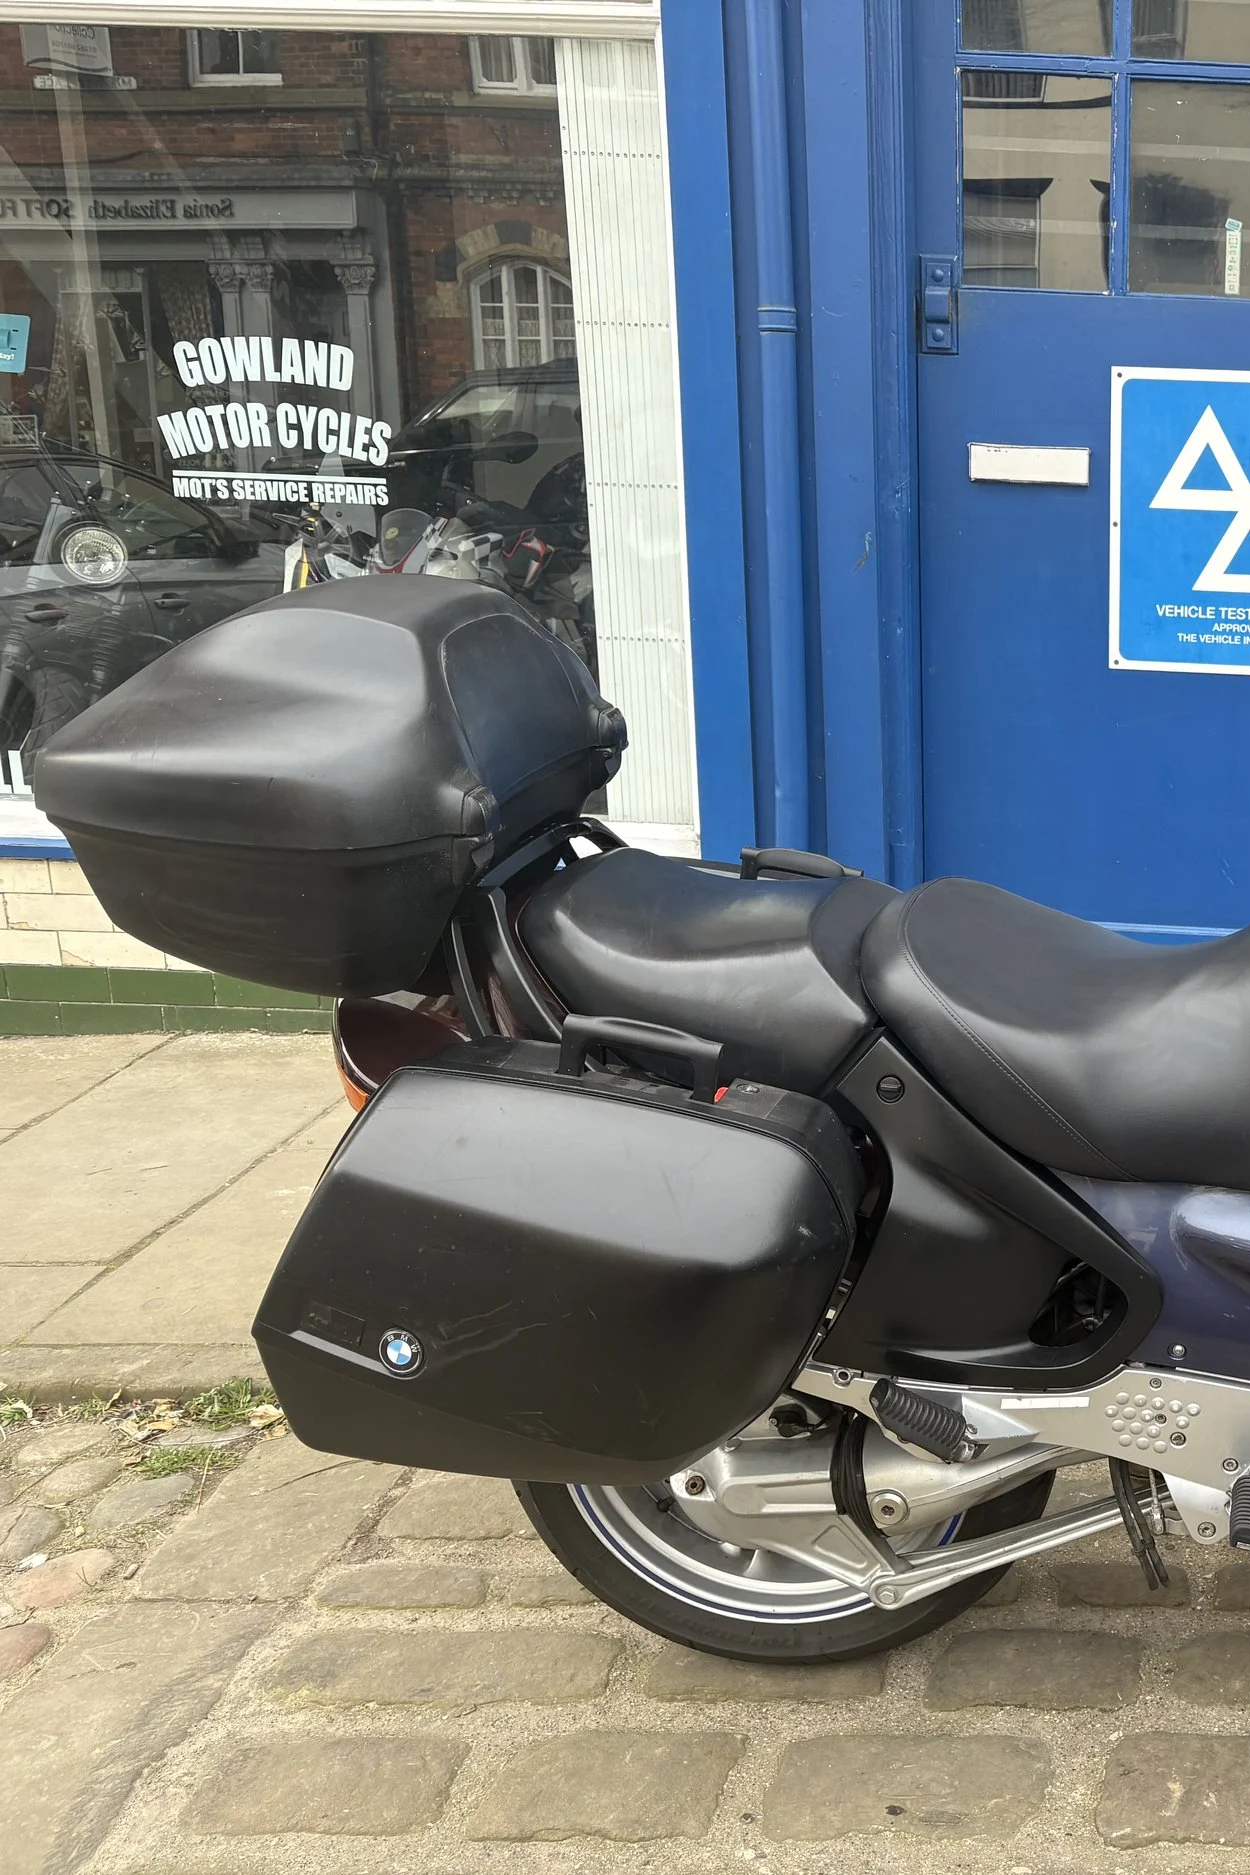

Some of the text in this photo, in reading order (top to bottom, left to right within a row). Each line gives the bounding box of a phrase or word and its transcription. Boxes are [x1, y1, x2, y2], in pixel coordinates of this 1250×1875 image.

[172, 336, 354, 391] GOWLAND
[156, 402, 392, 467] MOTOR CYCLES
[172, 477, 389, 506] MOT'S SERVICE REPAIRS
[1155, 604, 1216, 619] VEHICLE
[1177, 633, 1197, 643] THE
[1199, 634, 1241, 645] VEHICLE
